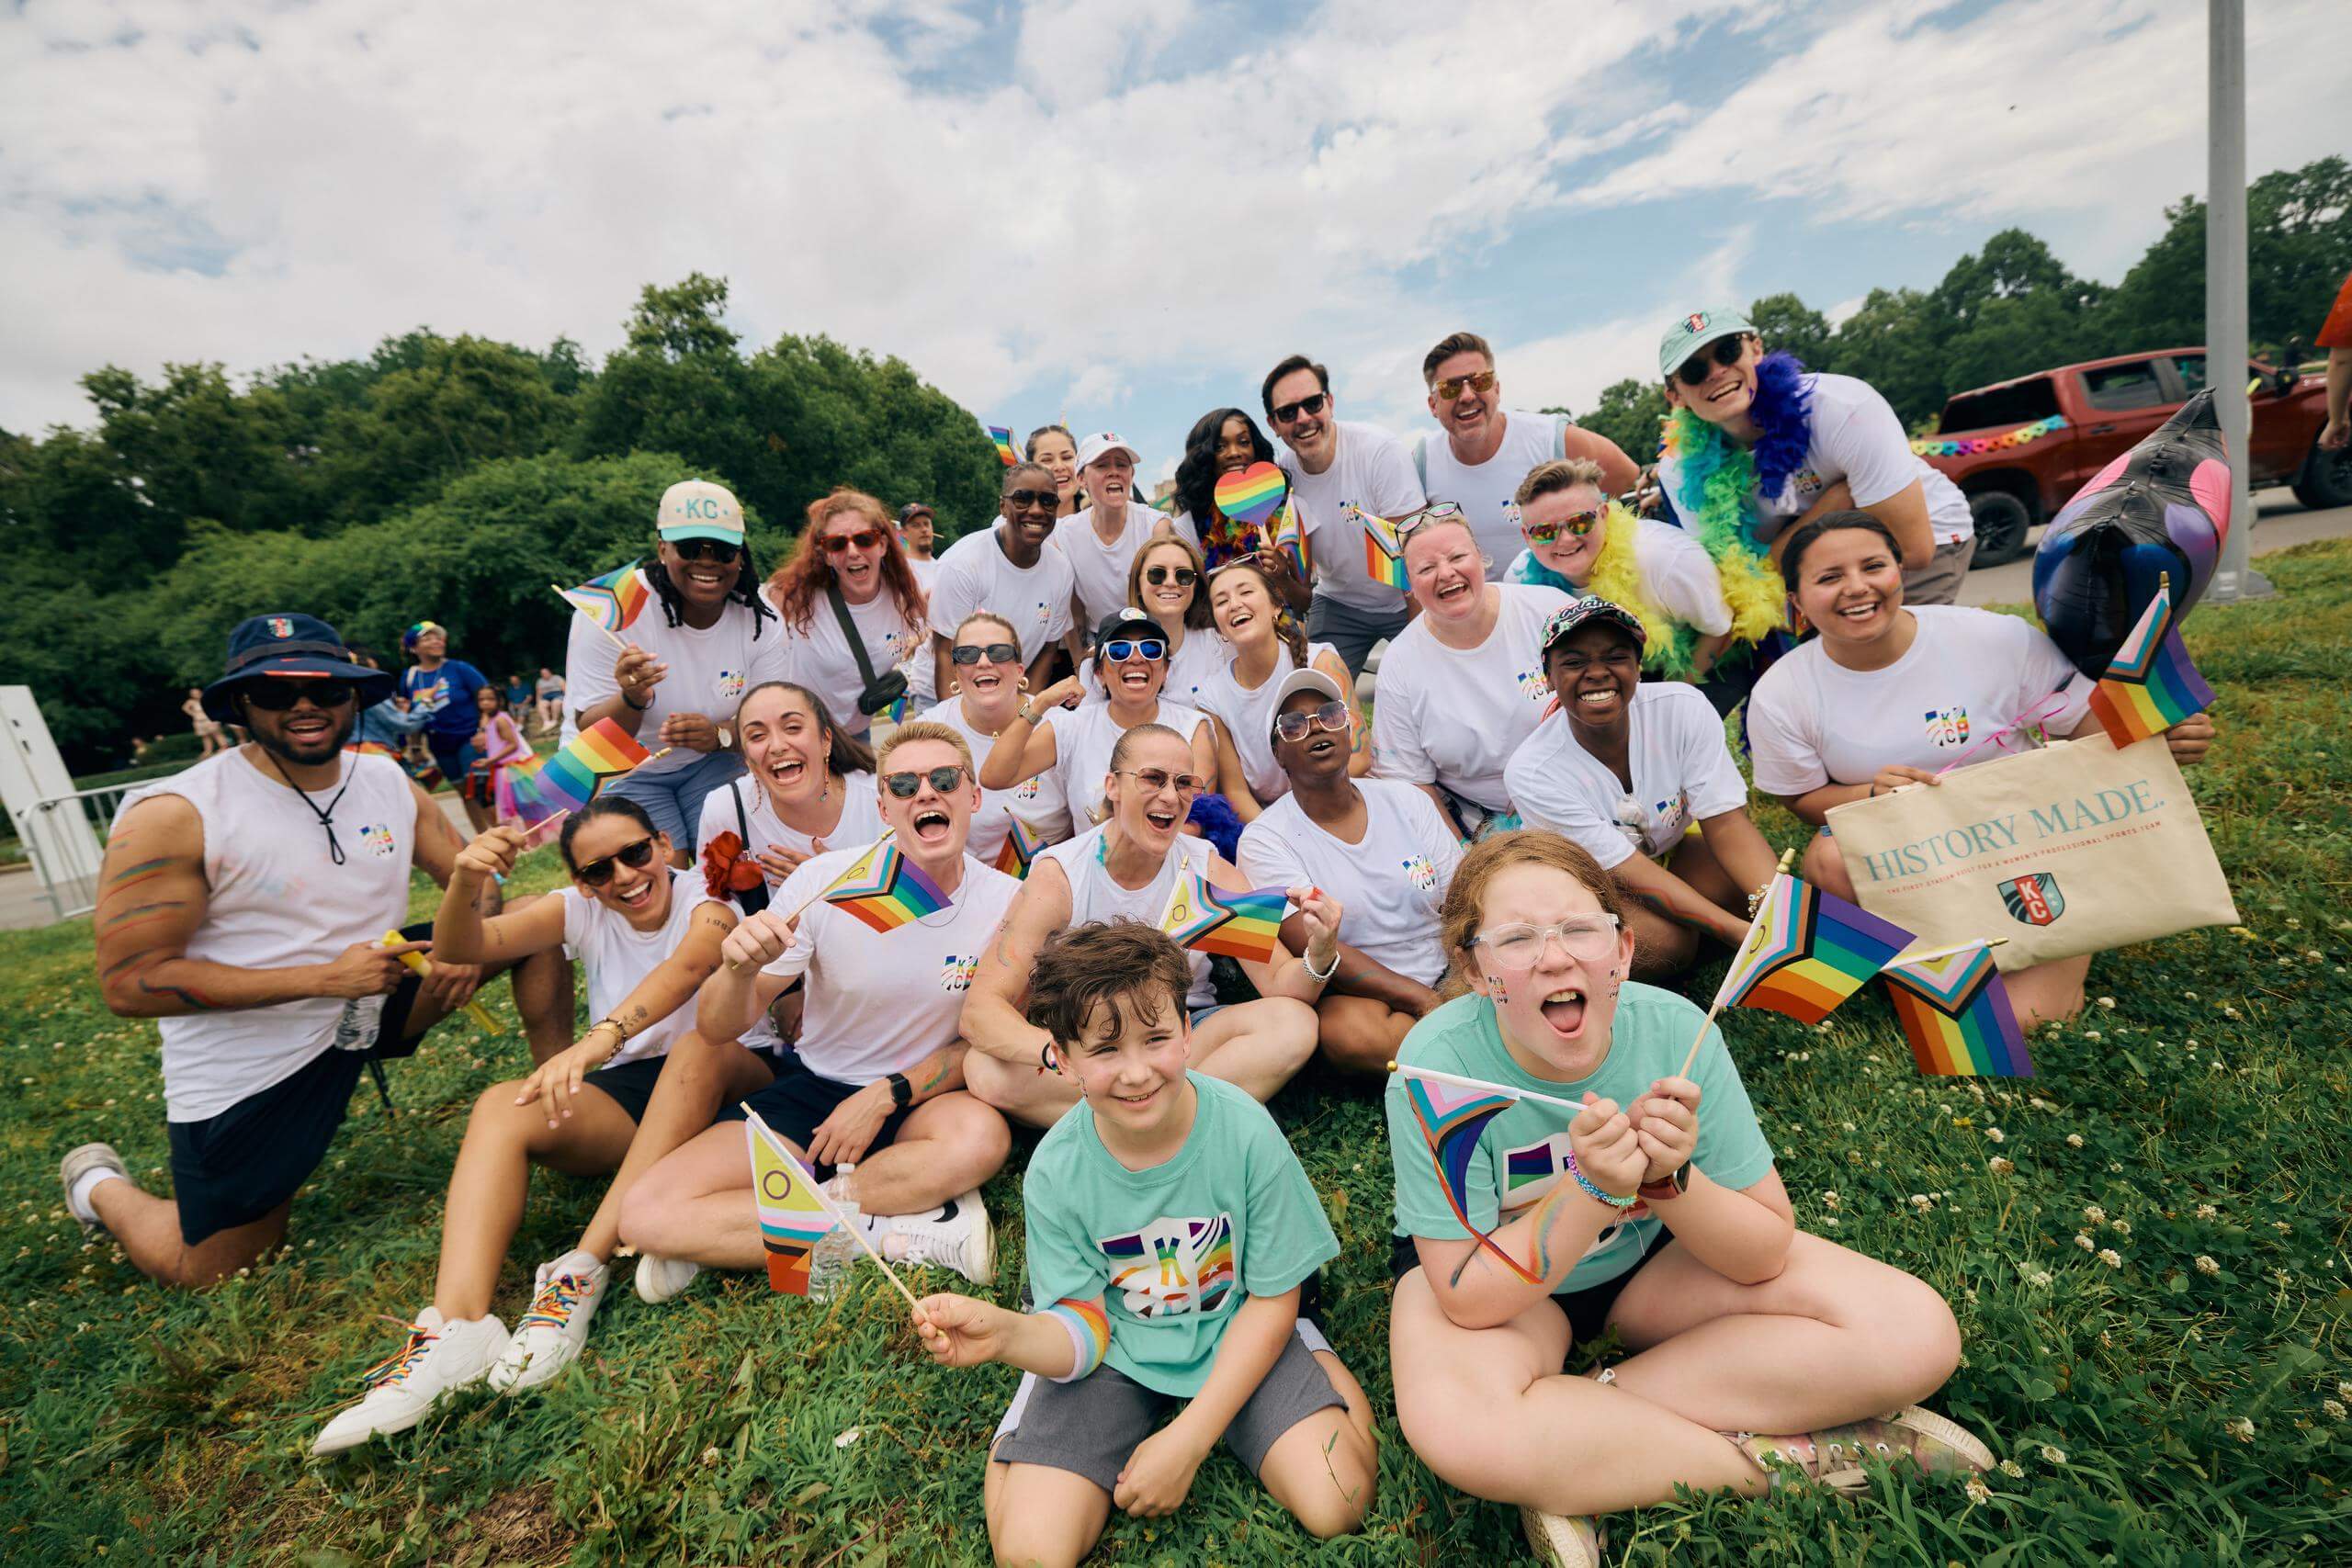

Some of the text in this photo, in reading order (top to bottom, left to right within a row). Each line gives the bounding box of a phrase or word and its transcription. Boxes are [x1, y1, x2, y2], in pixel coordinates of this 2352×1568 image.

[685, 498, 718, 519] KC
[1863, 780, 2165, 882] HISTORY MADE.
[1903, 883, 1924, 891] FIRST
[2003, 852, 2038, 864] WOMEN'S
[2041, 837, 2102, 855] PROFESSIONAL
[2104, 828, 2137, 840] SPORTS
[2140, 820, 2161, 831] TEAM
[2018, 881, 2048, 919] KC
